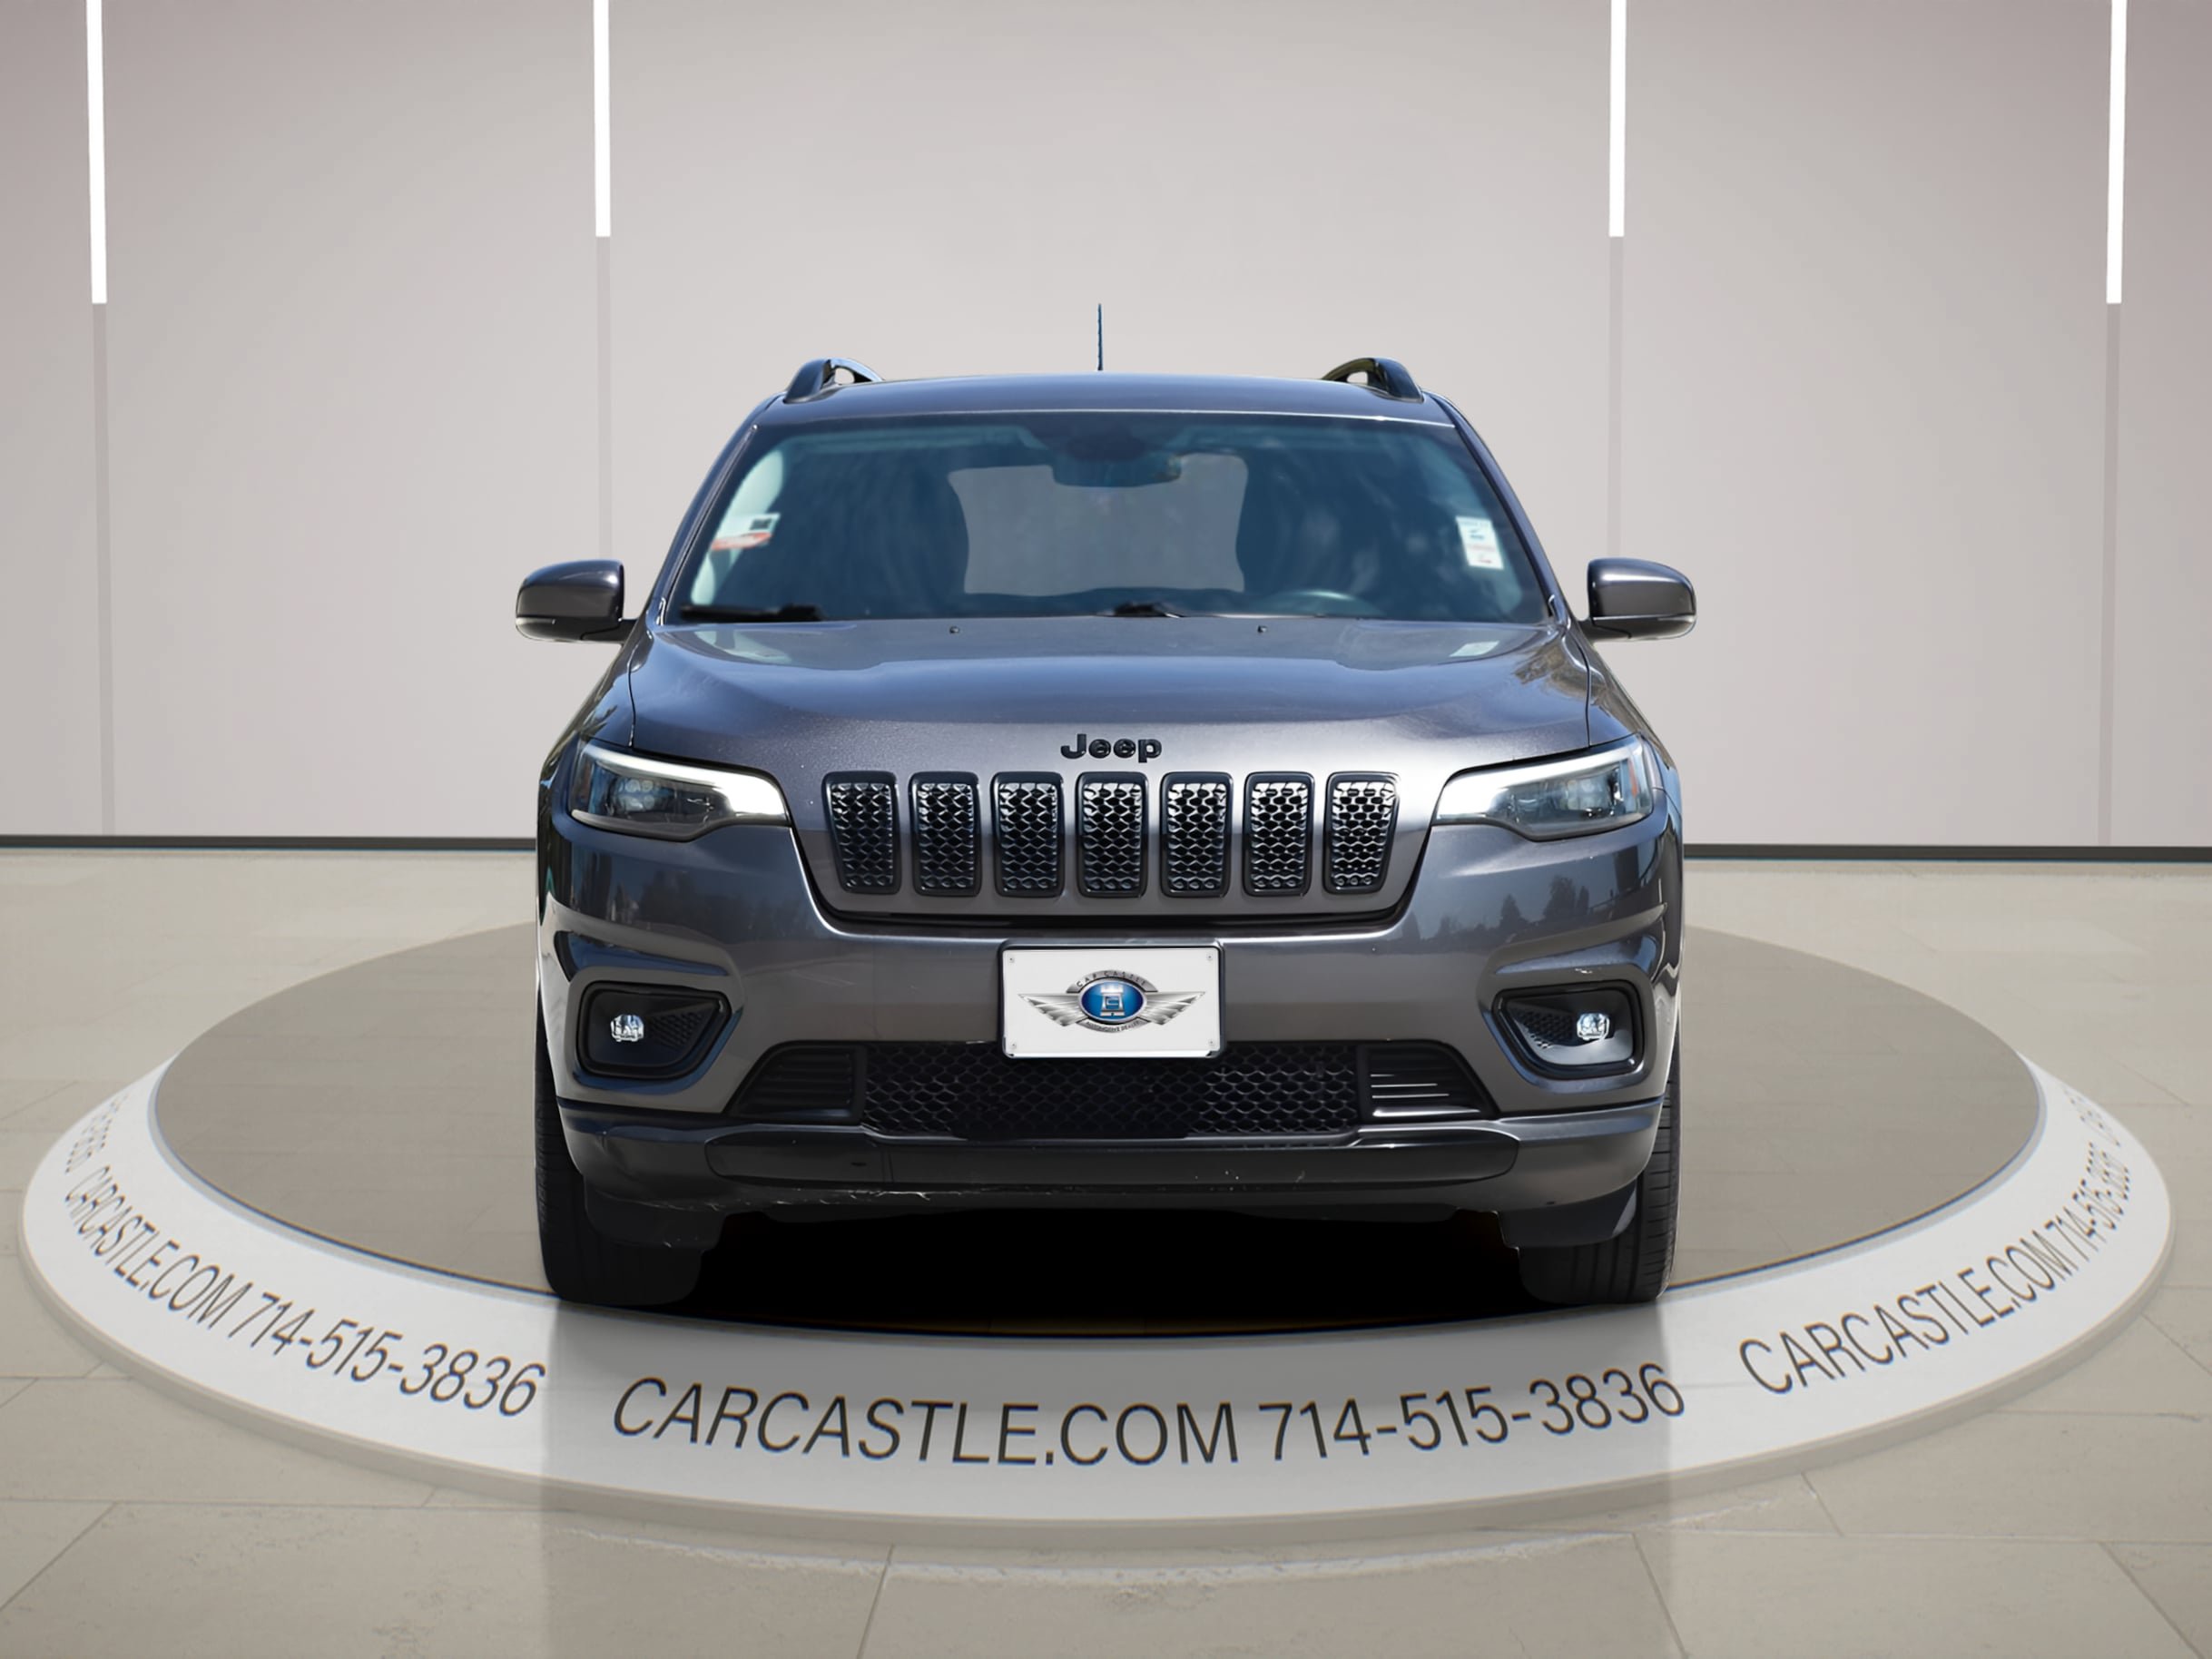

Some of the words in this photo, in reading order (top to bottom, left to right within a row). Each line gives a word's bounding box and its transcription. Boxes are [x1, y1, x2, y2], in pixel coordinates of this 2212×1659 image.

[1060, 733, 1162, 763] Jeep
[64, 1165, 254, 1330] CARCASTLE.COM
[228, 1291, 546, 1417] 714-515-3836
[1739, 1229, 2079, 1394] CARCASTLE.COM
[613, 1376, 1240, 1467] CARCASTLE.COM
[1258, 1363, 1686, 1462] 714-515-3836
